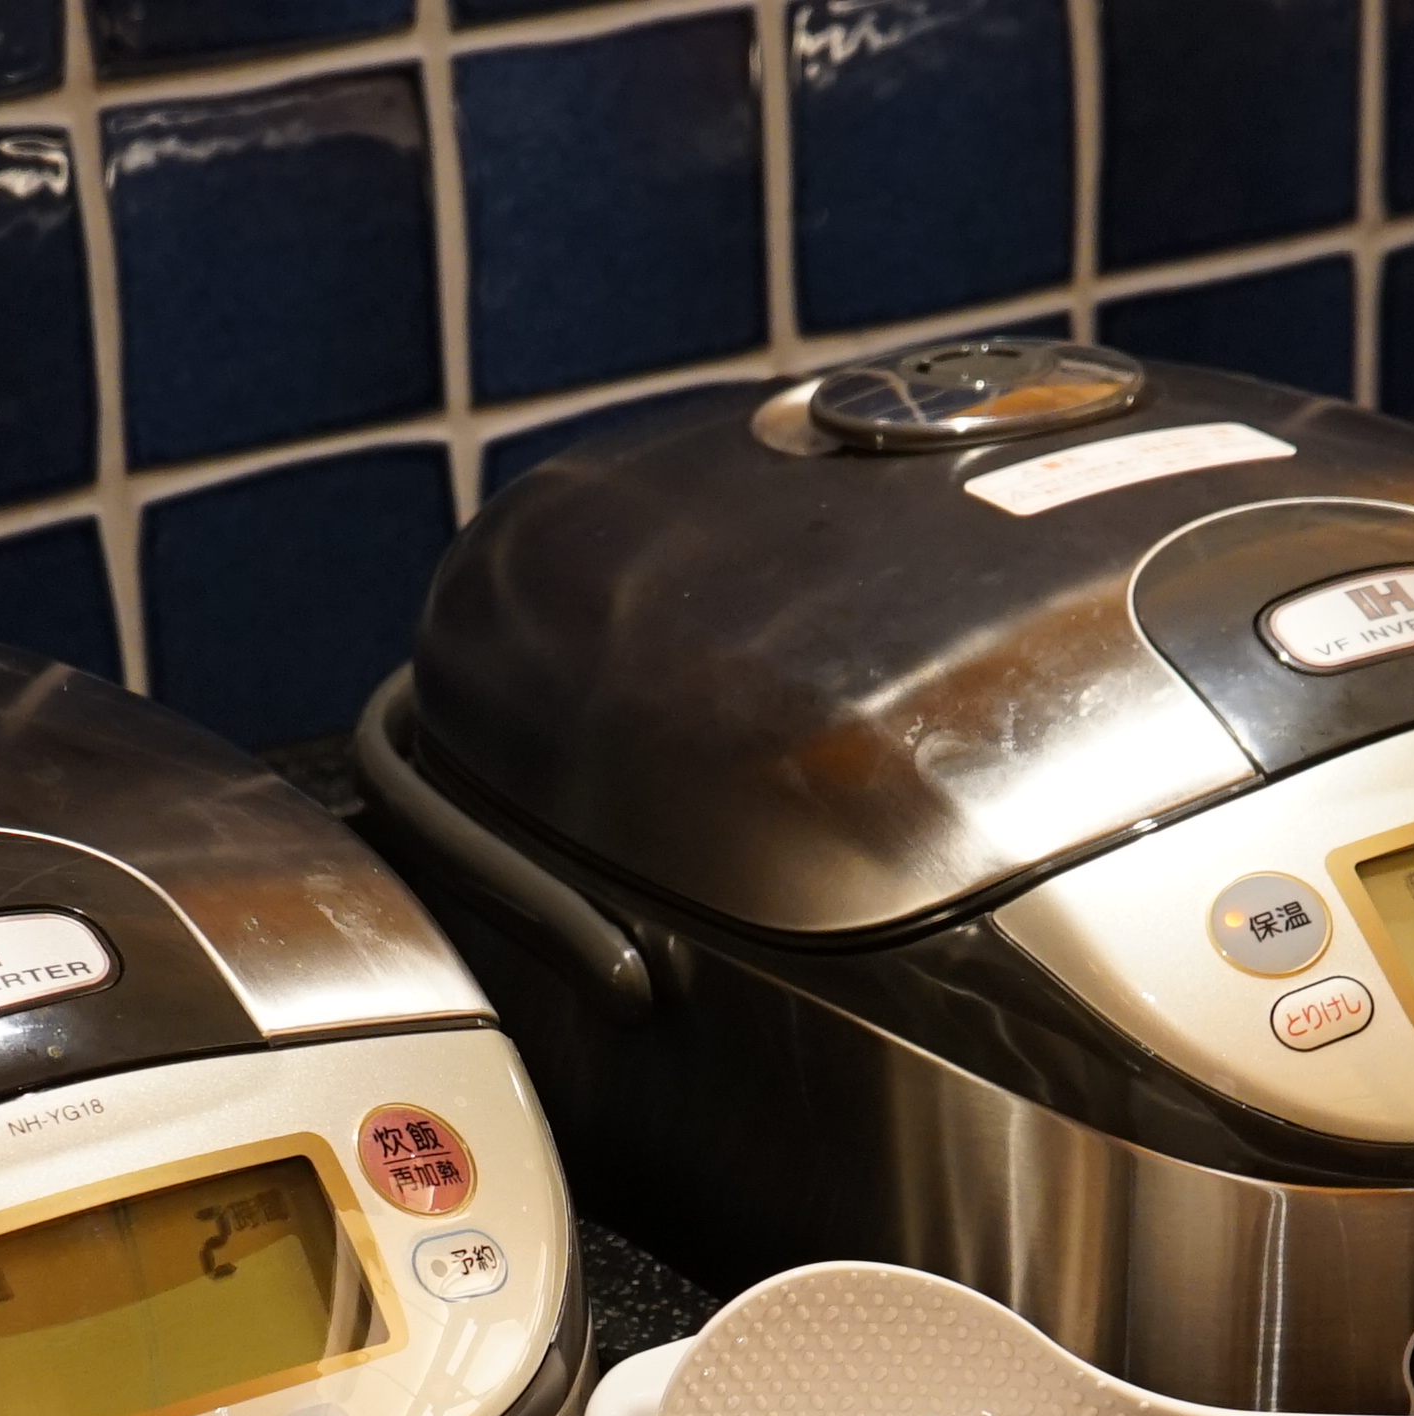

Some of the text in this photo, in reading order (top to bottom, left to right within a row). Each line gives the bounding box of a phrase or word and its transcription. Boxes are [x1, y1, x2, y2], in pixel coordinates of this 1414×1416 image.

[1314, 638, 1349, 657] VF
[1249, 900, 1312, 943] 保温
[1287, 993, 1361, 1036] とりけし
[8, 1098, 105, 1137] NH-YG18
[373, 1121, 444, 1158] 炊飯
[390, 1161, 465, 1194] 再加熱
[451, 1245, 498, 1275] 予約
